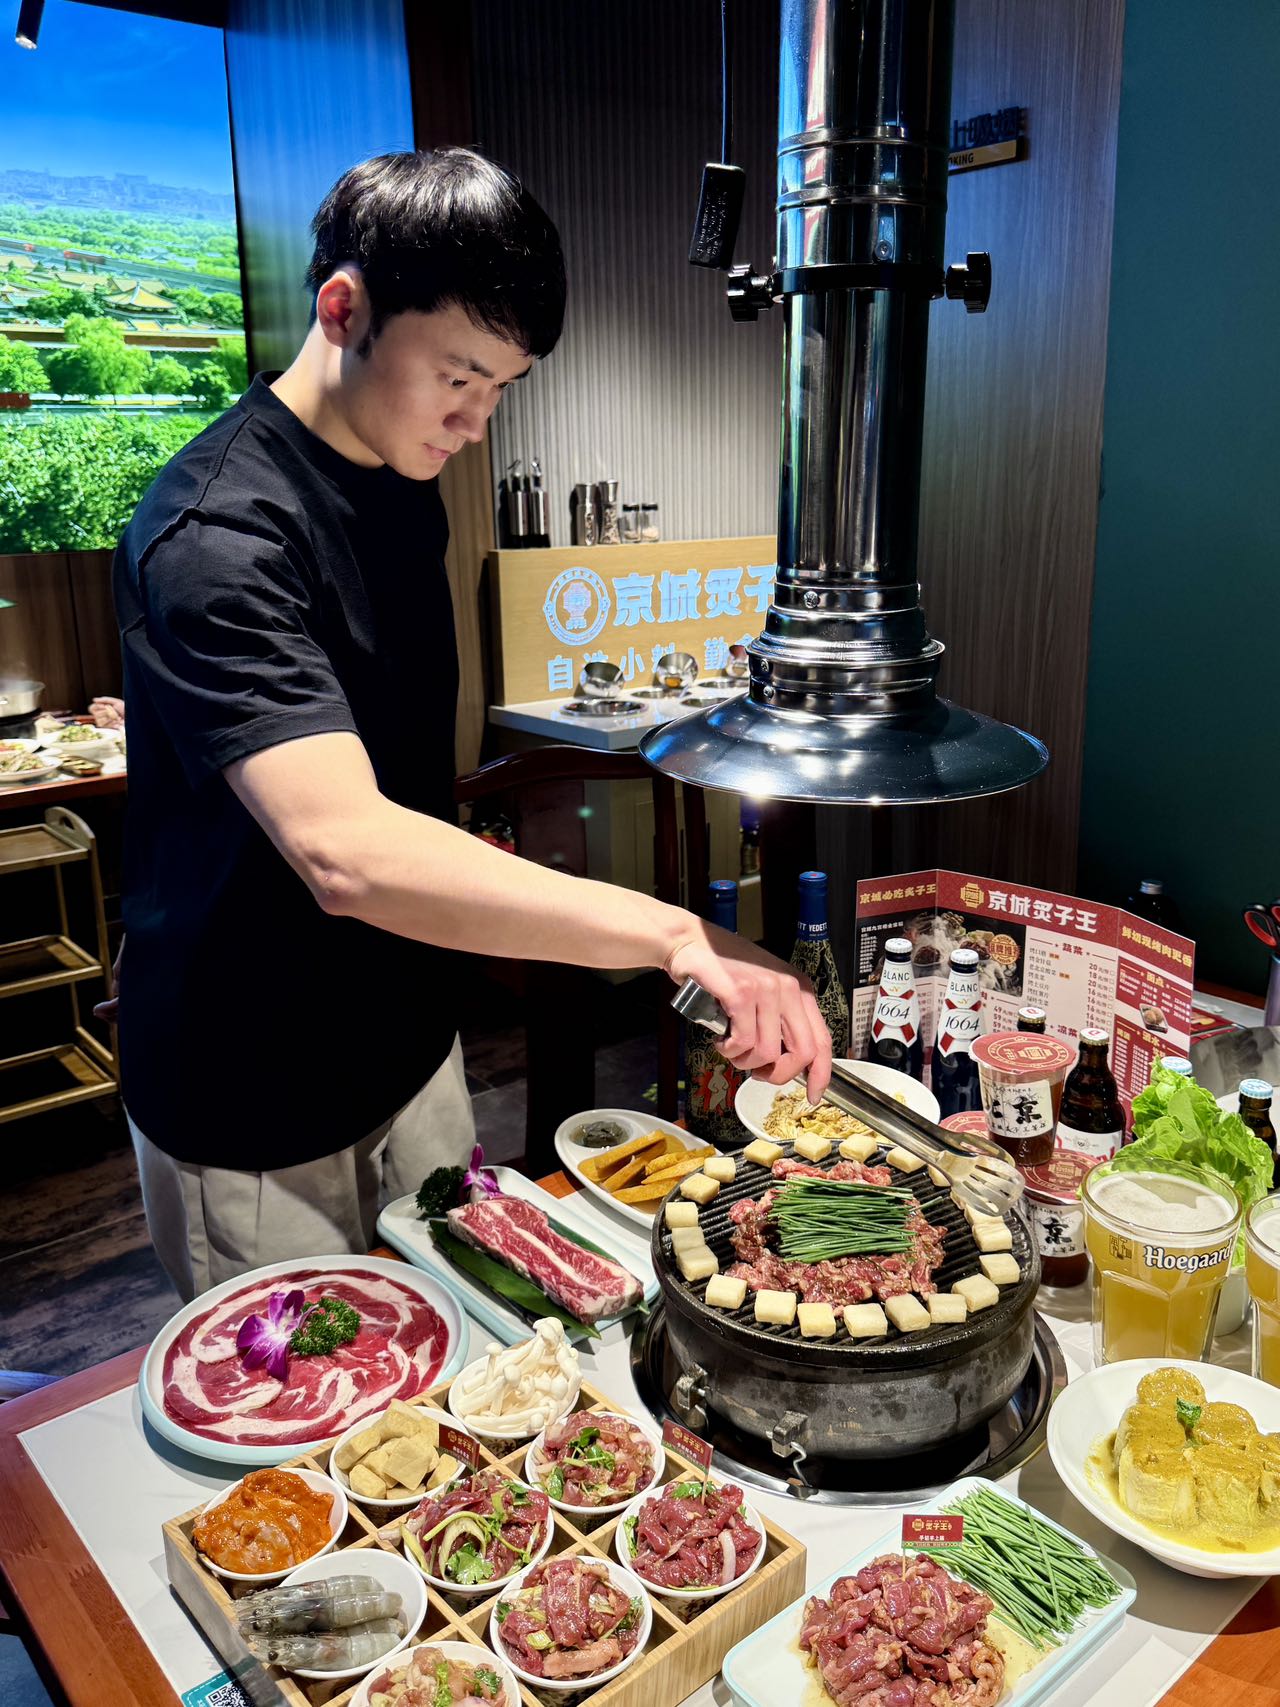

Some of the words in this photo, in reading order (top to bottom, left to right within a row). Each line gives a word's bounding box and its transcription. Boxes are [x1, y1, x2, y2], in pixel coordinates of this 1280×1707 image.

[988, 890, 1097, 934] 京城炙子王
[883, 969, 910, 982] BLANC
[950, 981, 978, 993] BLANC
[878, 1003, 911, 1020] 1664
[945, 1015, 981, 1032] 1664
